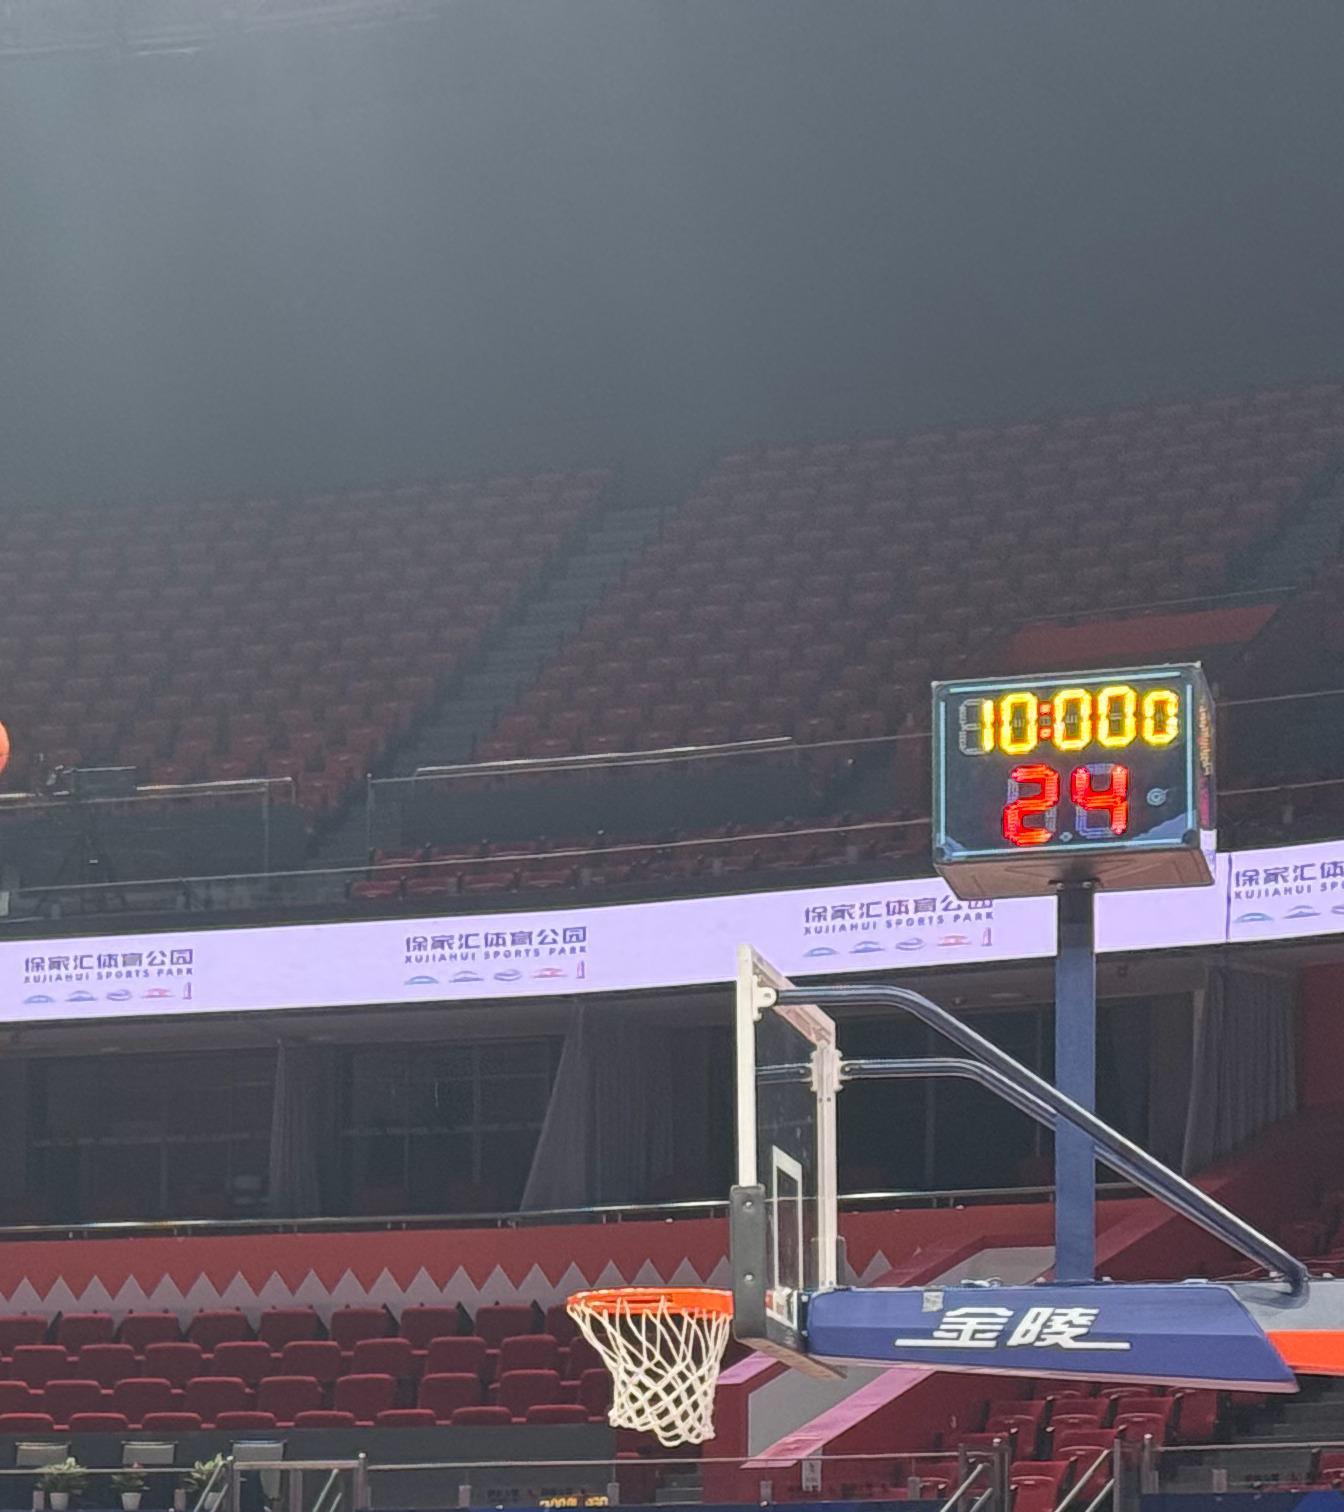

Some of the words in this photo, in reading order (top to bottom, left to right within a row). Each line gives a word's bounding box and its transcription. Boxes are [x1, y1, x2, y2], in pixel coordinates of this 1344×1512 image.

[1001, 763, 1128, 847] 24
[1234, 884, 1311, 899] XUJIAHUI
[803, 920, 876, 936] XUJIAHUI
[885, 914, 944, 928] SPORTS
[953, 911, 993, 922] PARK
[406, 926, 586, 952] 徐家汇体育公园
[25, 948, 193, 973] 徐家汇体育公园
[404, 951, 476, 963] XUJIAHUI
[484, 947, 540, 960] SPORTS
[549, 945, 586, 956] PARK
[24, 972, 89, 983] XUJIAHUI
[97, 969, 150, 980] SPORTS
[156, 967, 193, 977] PARK
[894, 1306, 1131, 1350] 金陵
